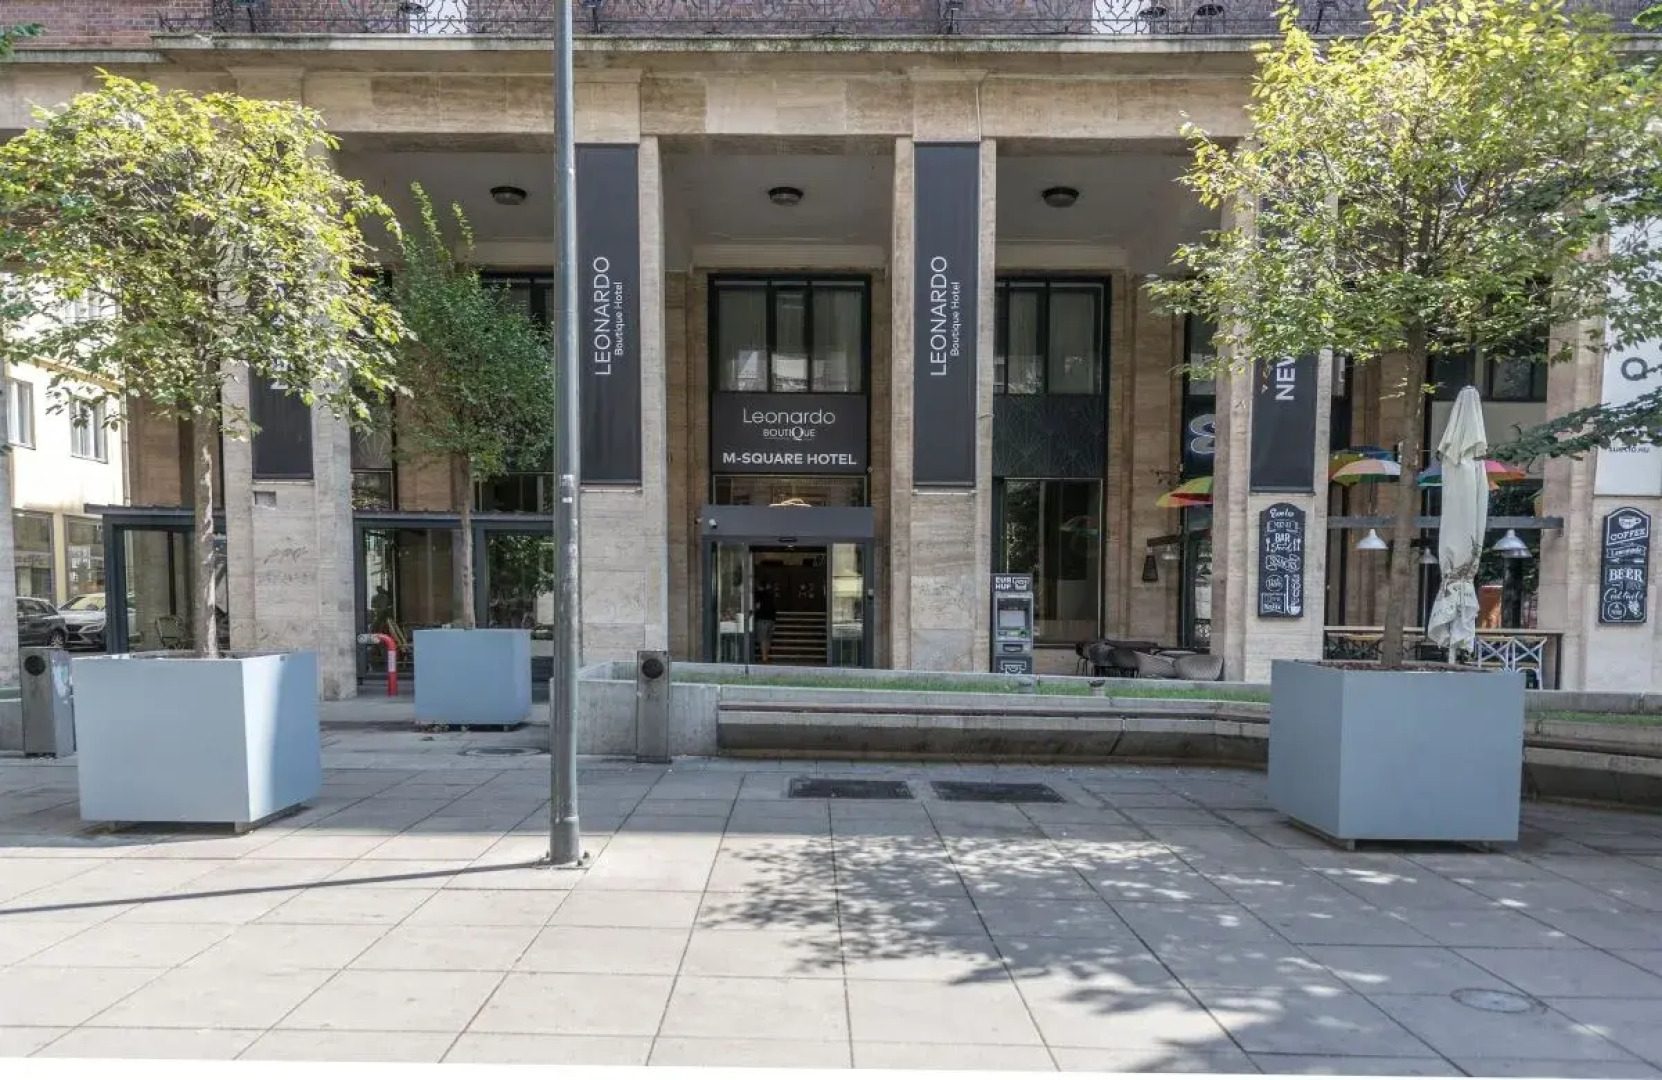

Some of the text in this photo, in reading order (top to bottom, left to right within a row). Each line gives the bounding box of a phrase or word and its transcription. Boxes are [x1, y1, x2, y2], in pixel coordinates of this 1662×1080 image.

[593, 256, 611, 375] LEONARDO
[613, 282, 625, 356] Boutique Hotel
[930, 256, 947, 376] LEONARDO
[950, 282, 961, 356] Boutique Hotel
[742, 407, 836, 425] Leonardo
[762, 426, 816, 441] BOUTIQUE
[722, 452, 857, 465] M-SQUARE HOTEL
[1610, 528, 1645, 541] COFFEE
[1608, 567, 1644, 582] BEER
